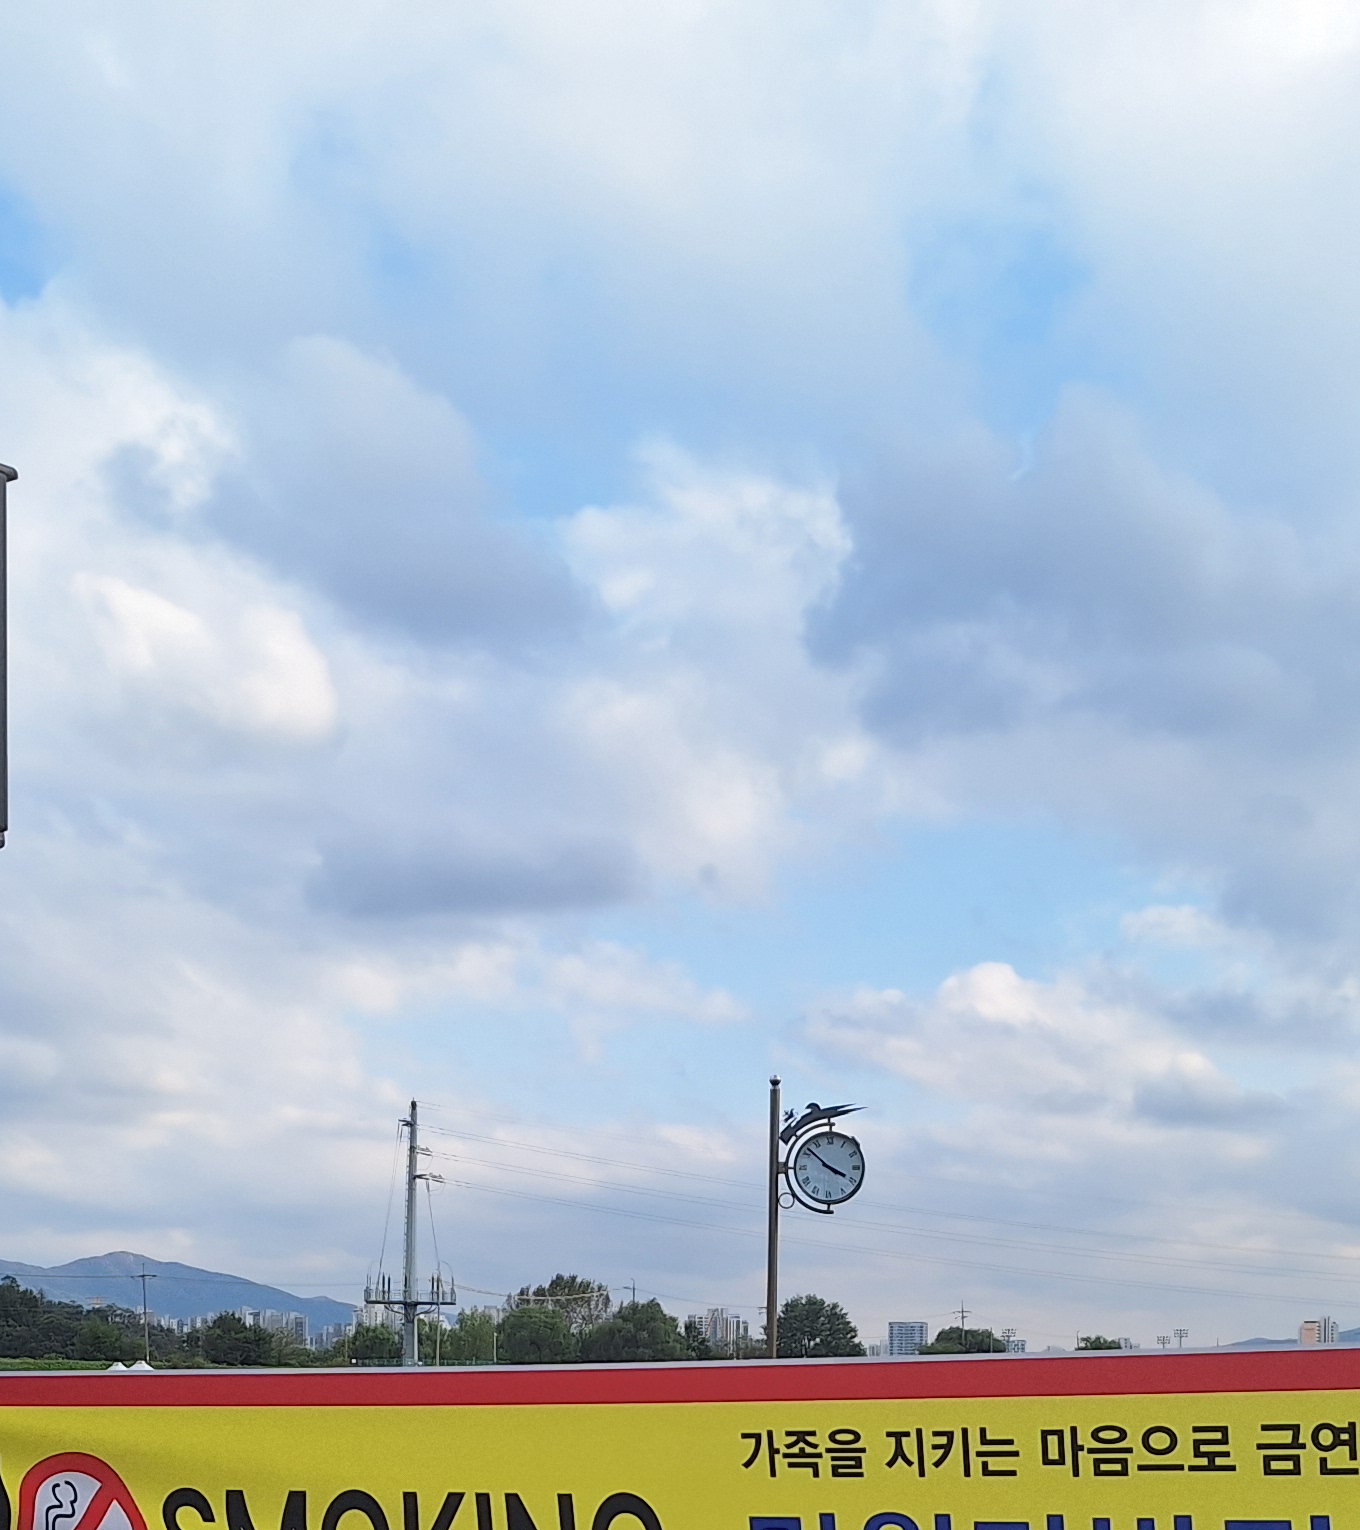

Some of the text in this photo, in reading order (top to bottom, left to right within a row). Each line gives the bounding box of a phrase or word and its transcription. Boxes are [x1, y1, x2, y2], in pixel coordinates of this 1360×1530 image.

[740, 1425, 869, 1480] 가족을
[884, 1425, 1021, 1479] 지키는
[1039, 1421, 1239, 1479] 마음으로
